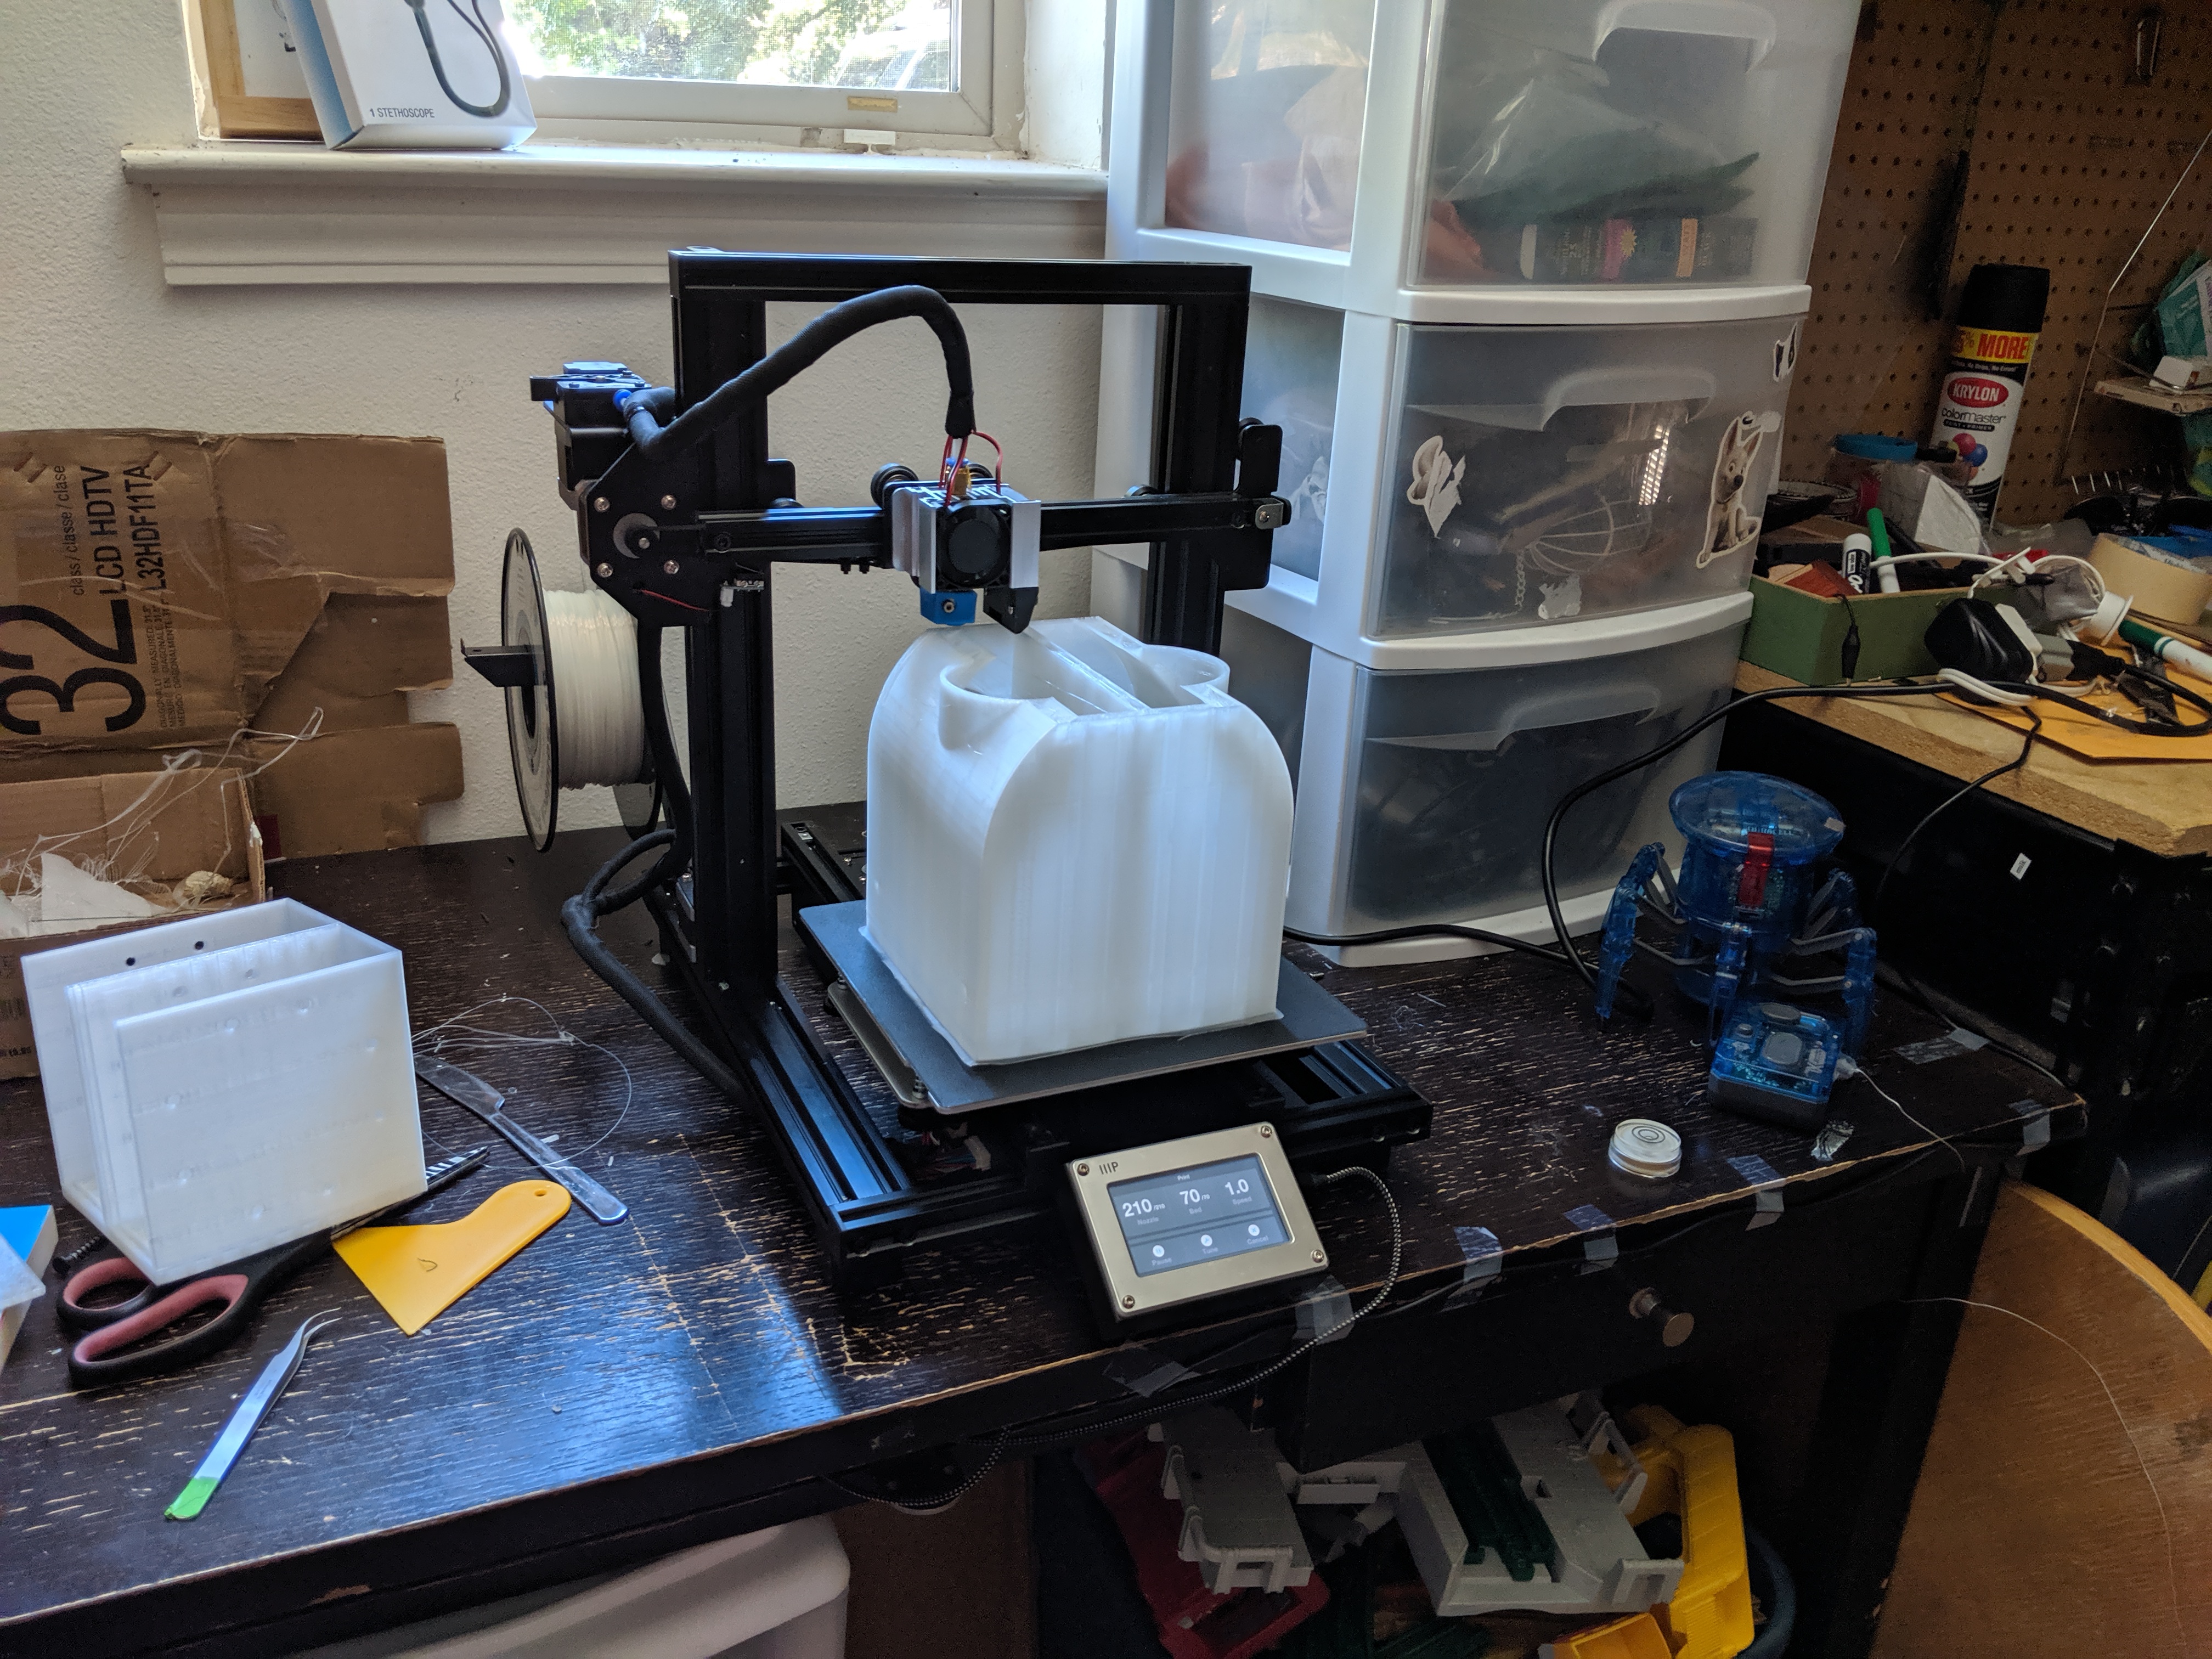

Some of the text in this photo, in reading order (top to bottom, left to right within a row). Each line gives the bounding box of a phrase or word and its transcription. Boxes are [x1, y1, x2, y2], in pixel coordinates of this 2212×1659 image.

[369, 108, 435, 118] 1 STETHOSCOPE
[1976, 333, 2029, 360] MORE
[1953, 383, 2000, 402] KRYLON
[80, 465, 127, 595] LCD HDTV
[123, 464, 167, 591] L32HDF11TA
[0, 599, 146, 735] 32
[1224, 1178, 1250, 1196] 1.0
[1232, 1196, 1252, 1205] Speed
[1189, 1206, 1203, 1215] Bed
[1246, 1235, 1269, 1245] Cancel
[1202, 1246, 1218, 1255] Tune
[1152, 1257, 1172, 1266] Pause
